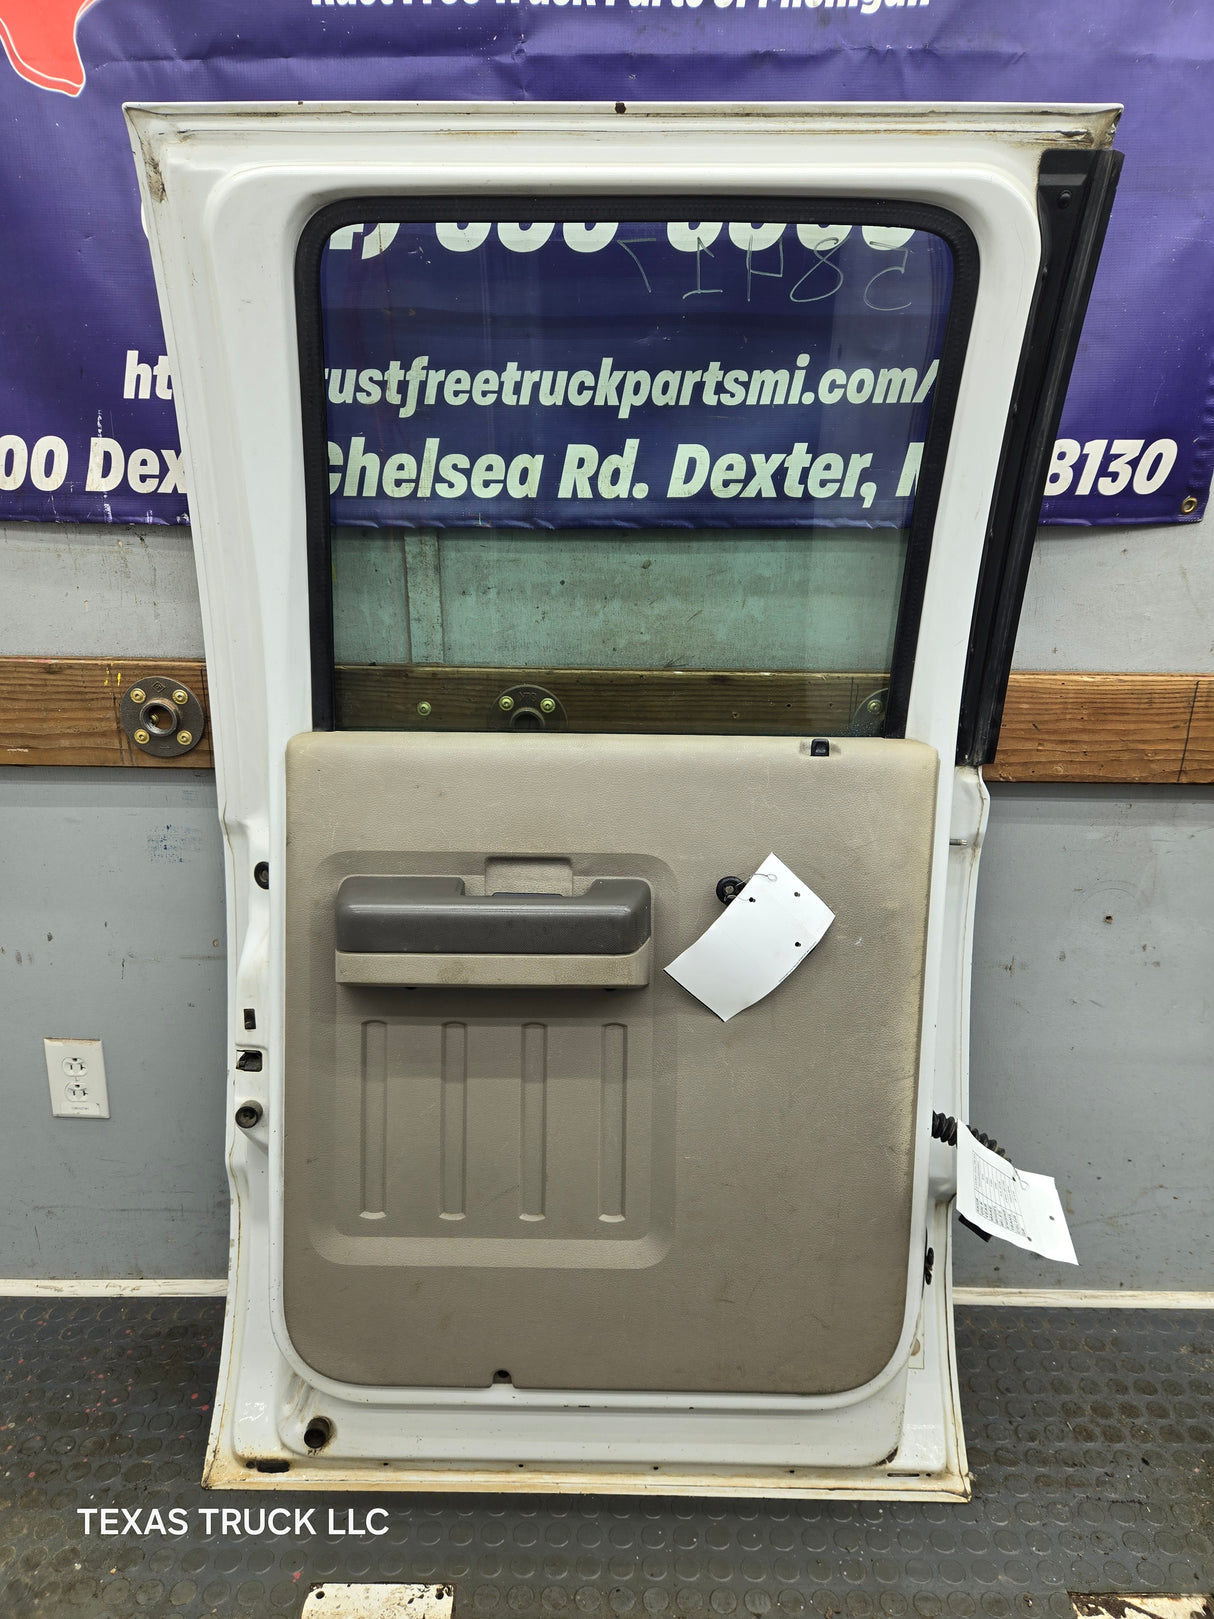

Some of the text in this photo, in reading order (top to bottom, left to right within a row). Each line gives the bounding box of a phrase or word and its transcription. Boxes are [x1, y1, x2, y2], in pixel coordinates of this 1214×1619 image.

[324, 354, 939, 418] ustfreetruckpartsmi.com/
[85, 437, 188, 494] Dex
[558, 438, 649, 498] Rd.
[667, 443, 877, 508] Dexter,
[1043, 438, 1178, 496] 8130
